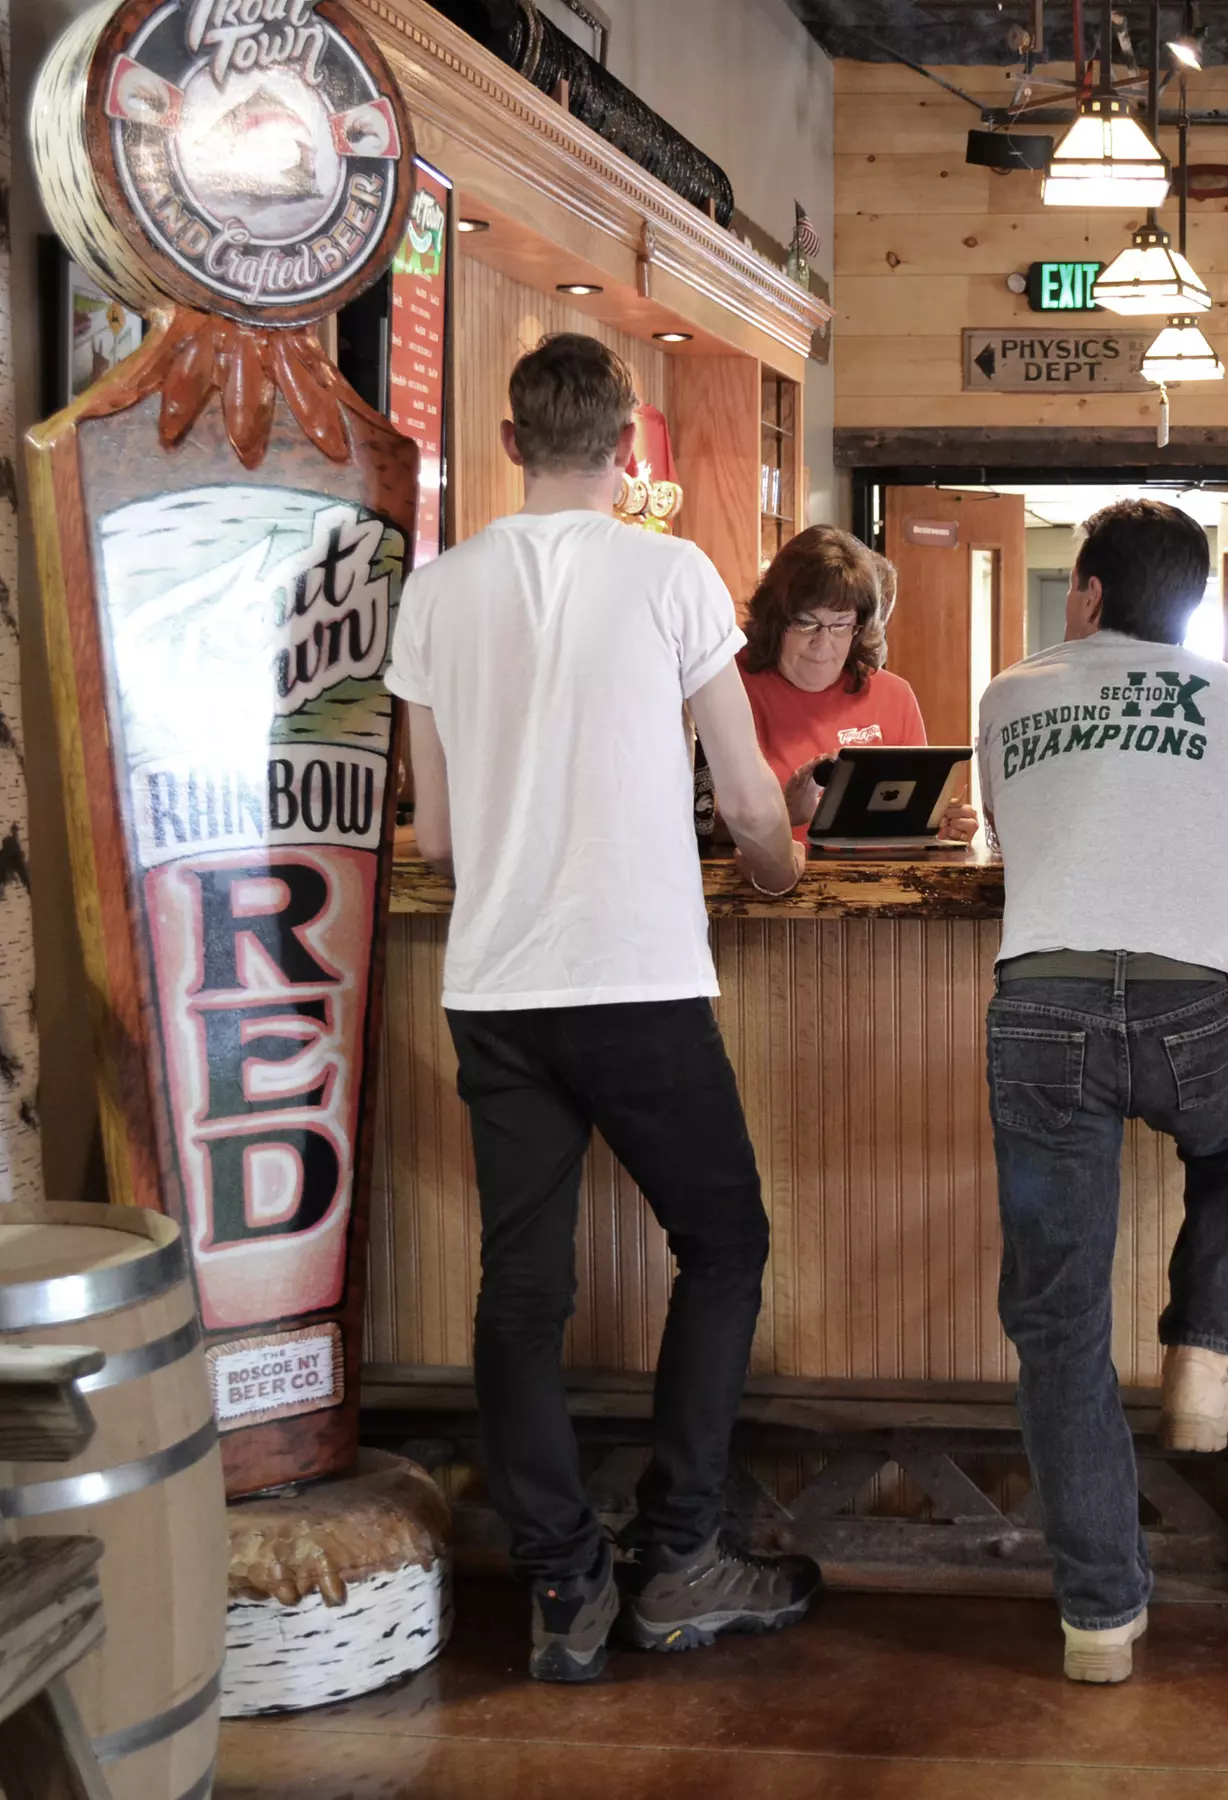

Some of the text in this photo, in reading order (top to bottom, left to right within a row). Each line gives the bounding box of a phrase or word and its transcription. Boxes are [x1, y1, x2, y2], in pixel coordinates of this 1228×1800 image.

[203, 22, 324, 86] Town
[203, 218, 319, 303] Crafted
[310, 172, 385, 276] BEER
[1041, 263, 1100, 309] EXIT
[1001, 338, 1120, 360] PHYSICS
[1024, 362, 1108, 382] DEPT.
[1099, 671, 1210, 727] SECTION IX
[1002, 704, 1111, 747] DEFENDING
[1003, 723, 1208, 781] CHAMPIONS
[146, 758, 374, 849] RAINBOW
[190, 863, 345, 1250] RED
[228, 1353, 320, 1385] ROSCOE NY
[262, 1349, 287, 1361] THE
[228, 1370, 324, 1404] BEER CO.
